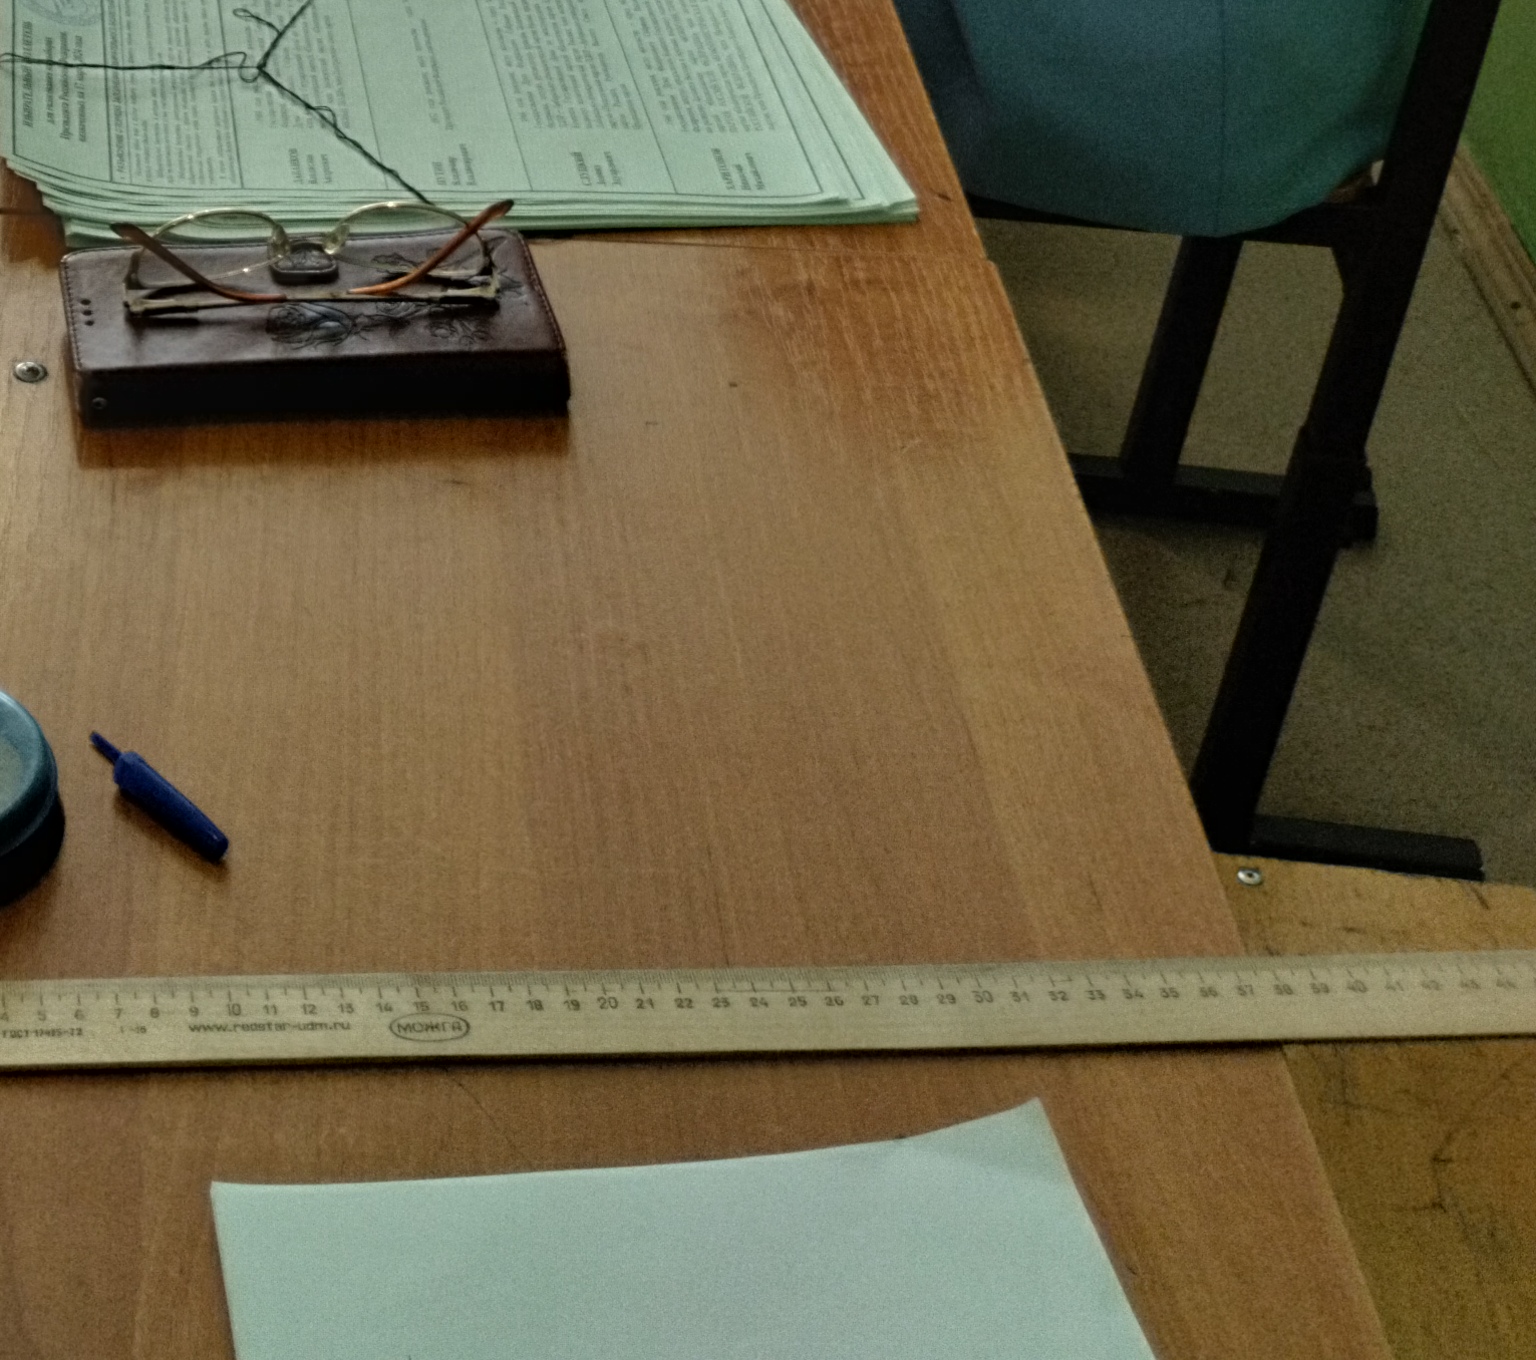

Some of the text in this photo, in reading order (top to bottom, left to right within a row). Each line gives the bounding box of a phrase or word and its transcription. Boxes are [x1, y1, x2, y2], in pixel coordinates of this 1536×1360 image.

[226, 1004, 241, 1016] 10
[263, 1005, 278, 1015] 11
[301, 1004, 317, 1015] 12
[338, 1003, 354, 1014] 13
[376, 1002, 393, 1012] 14
[413, 1001, 430, 1011] 15
[451, 1001, 468, 1011] 16
[489, 1001, 505, 1011] 17
[526, 1000, 543, 1010] 18
[564, 999, 581, 1010] 19
[597, 997, 618, 1009] 20
[636, 998, 654, 1009] 21
[675, 998, 694, 1008] 22
[712, 997, 730, 1008] 23
[750, 997, 768, 1007] 24
[789, 997, 807, 1007] 25
[825, 996, 843, 1006] 26
[862, 995, 879, 1006] 27
[899, 995, 918, 1005] 28
[936, 994, 957, 1004] 29
[971, 991, 993, 1003] 30
[1010, 991, 1029, 1002] 31
[1049, 991, 1068, 1001] 32
[1085, 990, 1105, 1000] 33
[1123, 989, 1143, 1000] 34
[189, 1020, 352, 1033] www.redstar-udm.ru
[398, 1021, 464, 1033] МОЖГА
